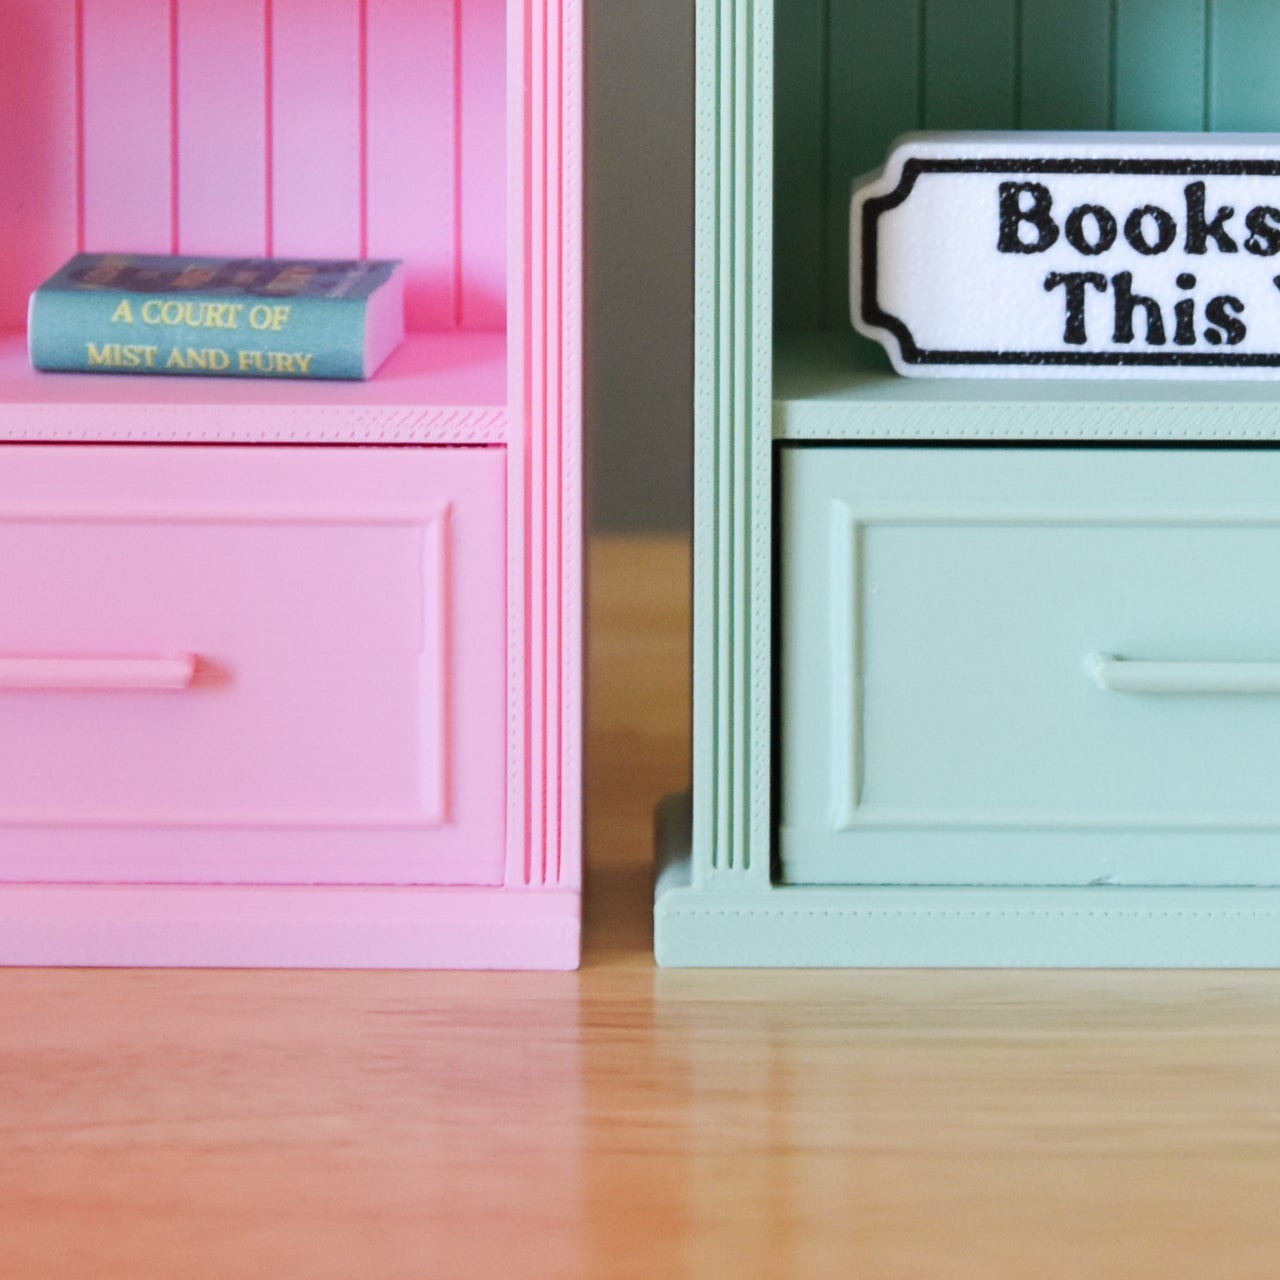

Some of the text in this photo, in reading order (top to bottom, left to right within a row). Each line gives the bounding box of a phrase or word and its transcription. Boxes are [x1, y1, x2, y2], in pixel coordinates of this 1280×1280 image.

[110, 300, 291, 331] A COURT OF
[1043, 270, 1247, 347] This
[86, 342, 313, 374] MIST AND FURY
